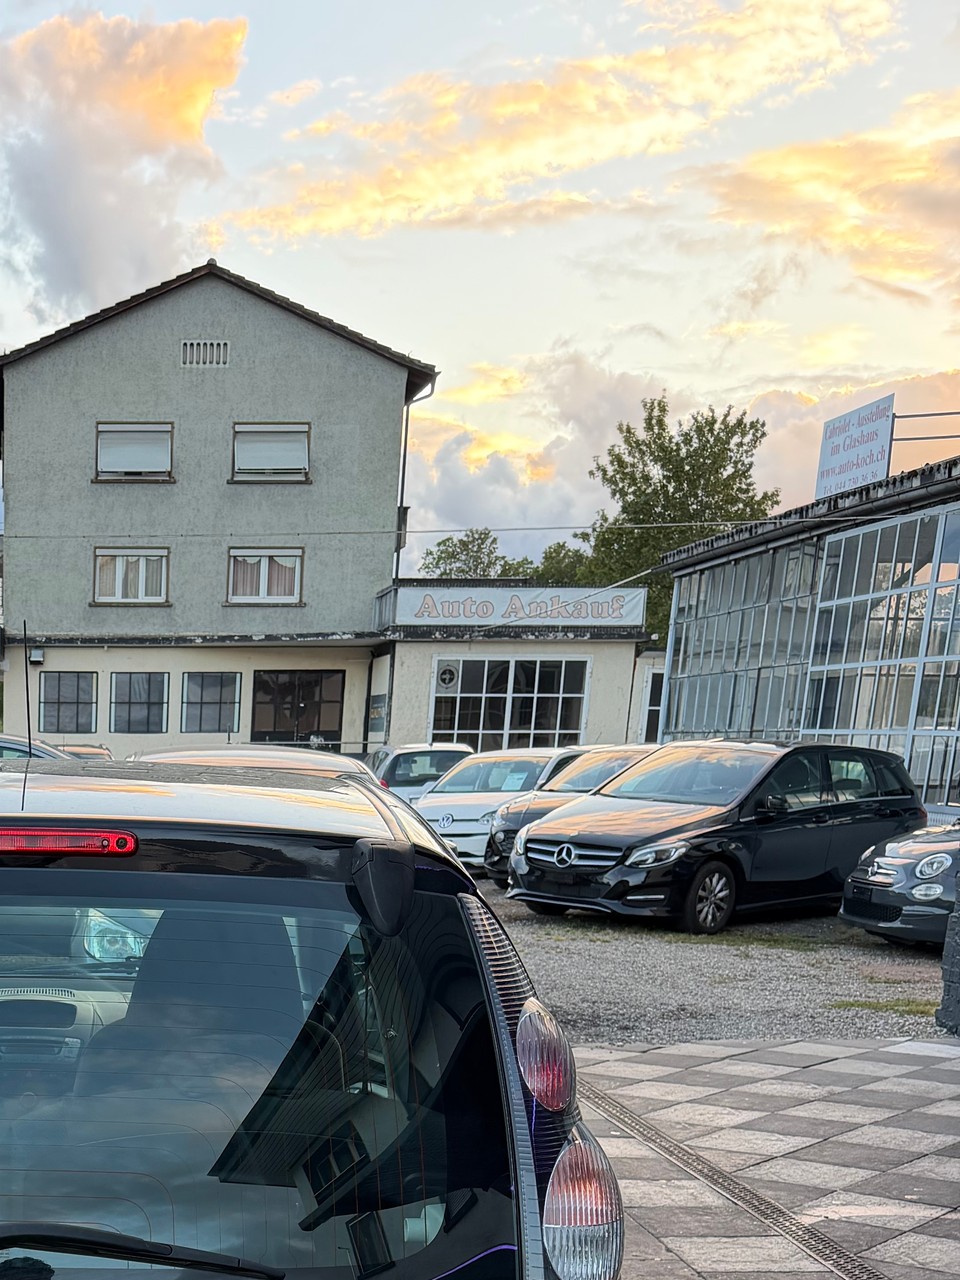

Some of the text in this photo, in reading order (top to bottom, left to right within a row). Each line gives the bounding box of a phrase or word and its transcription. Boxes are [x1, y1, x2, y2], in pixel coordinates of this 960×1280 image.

[825, 418, 851, 440] Cabriolet
[856, 404, 891, 429] Ausstellung
[830, 429, 879, 457] im Glashaus
[820, 444, 886, 480] www.auto-koch.ch
[414, 593, 626, 619] Auto Ankauf
